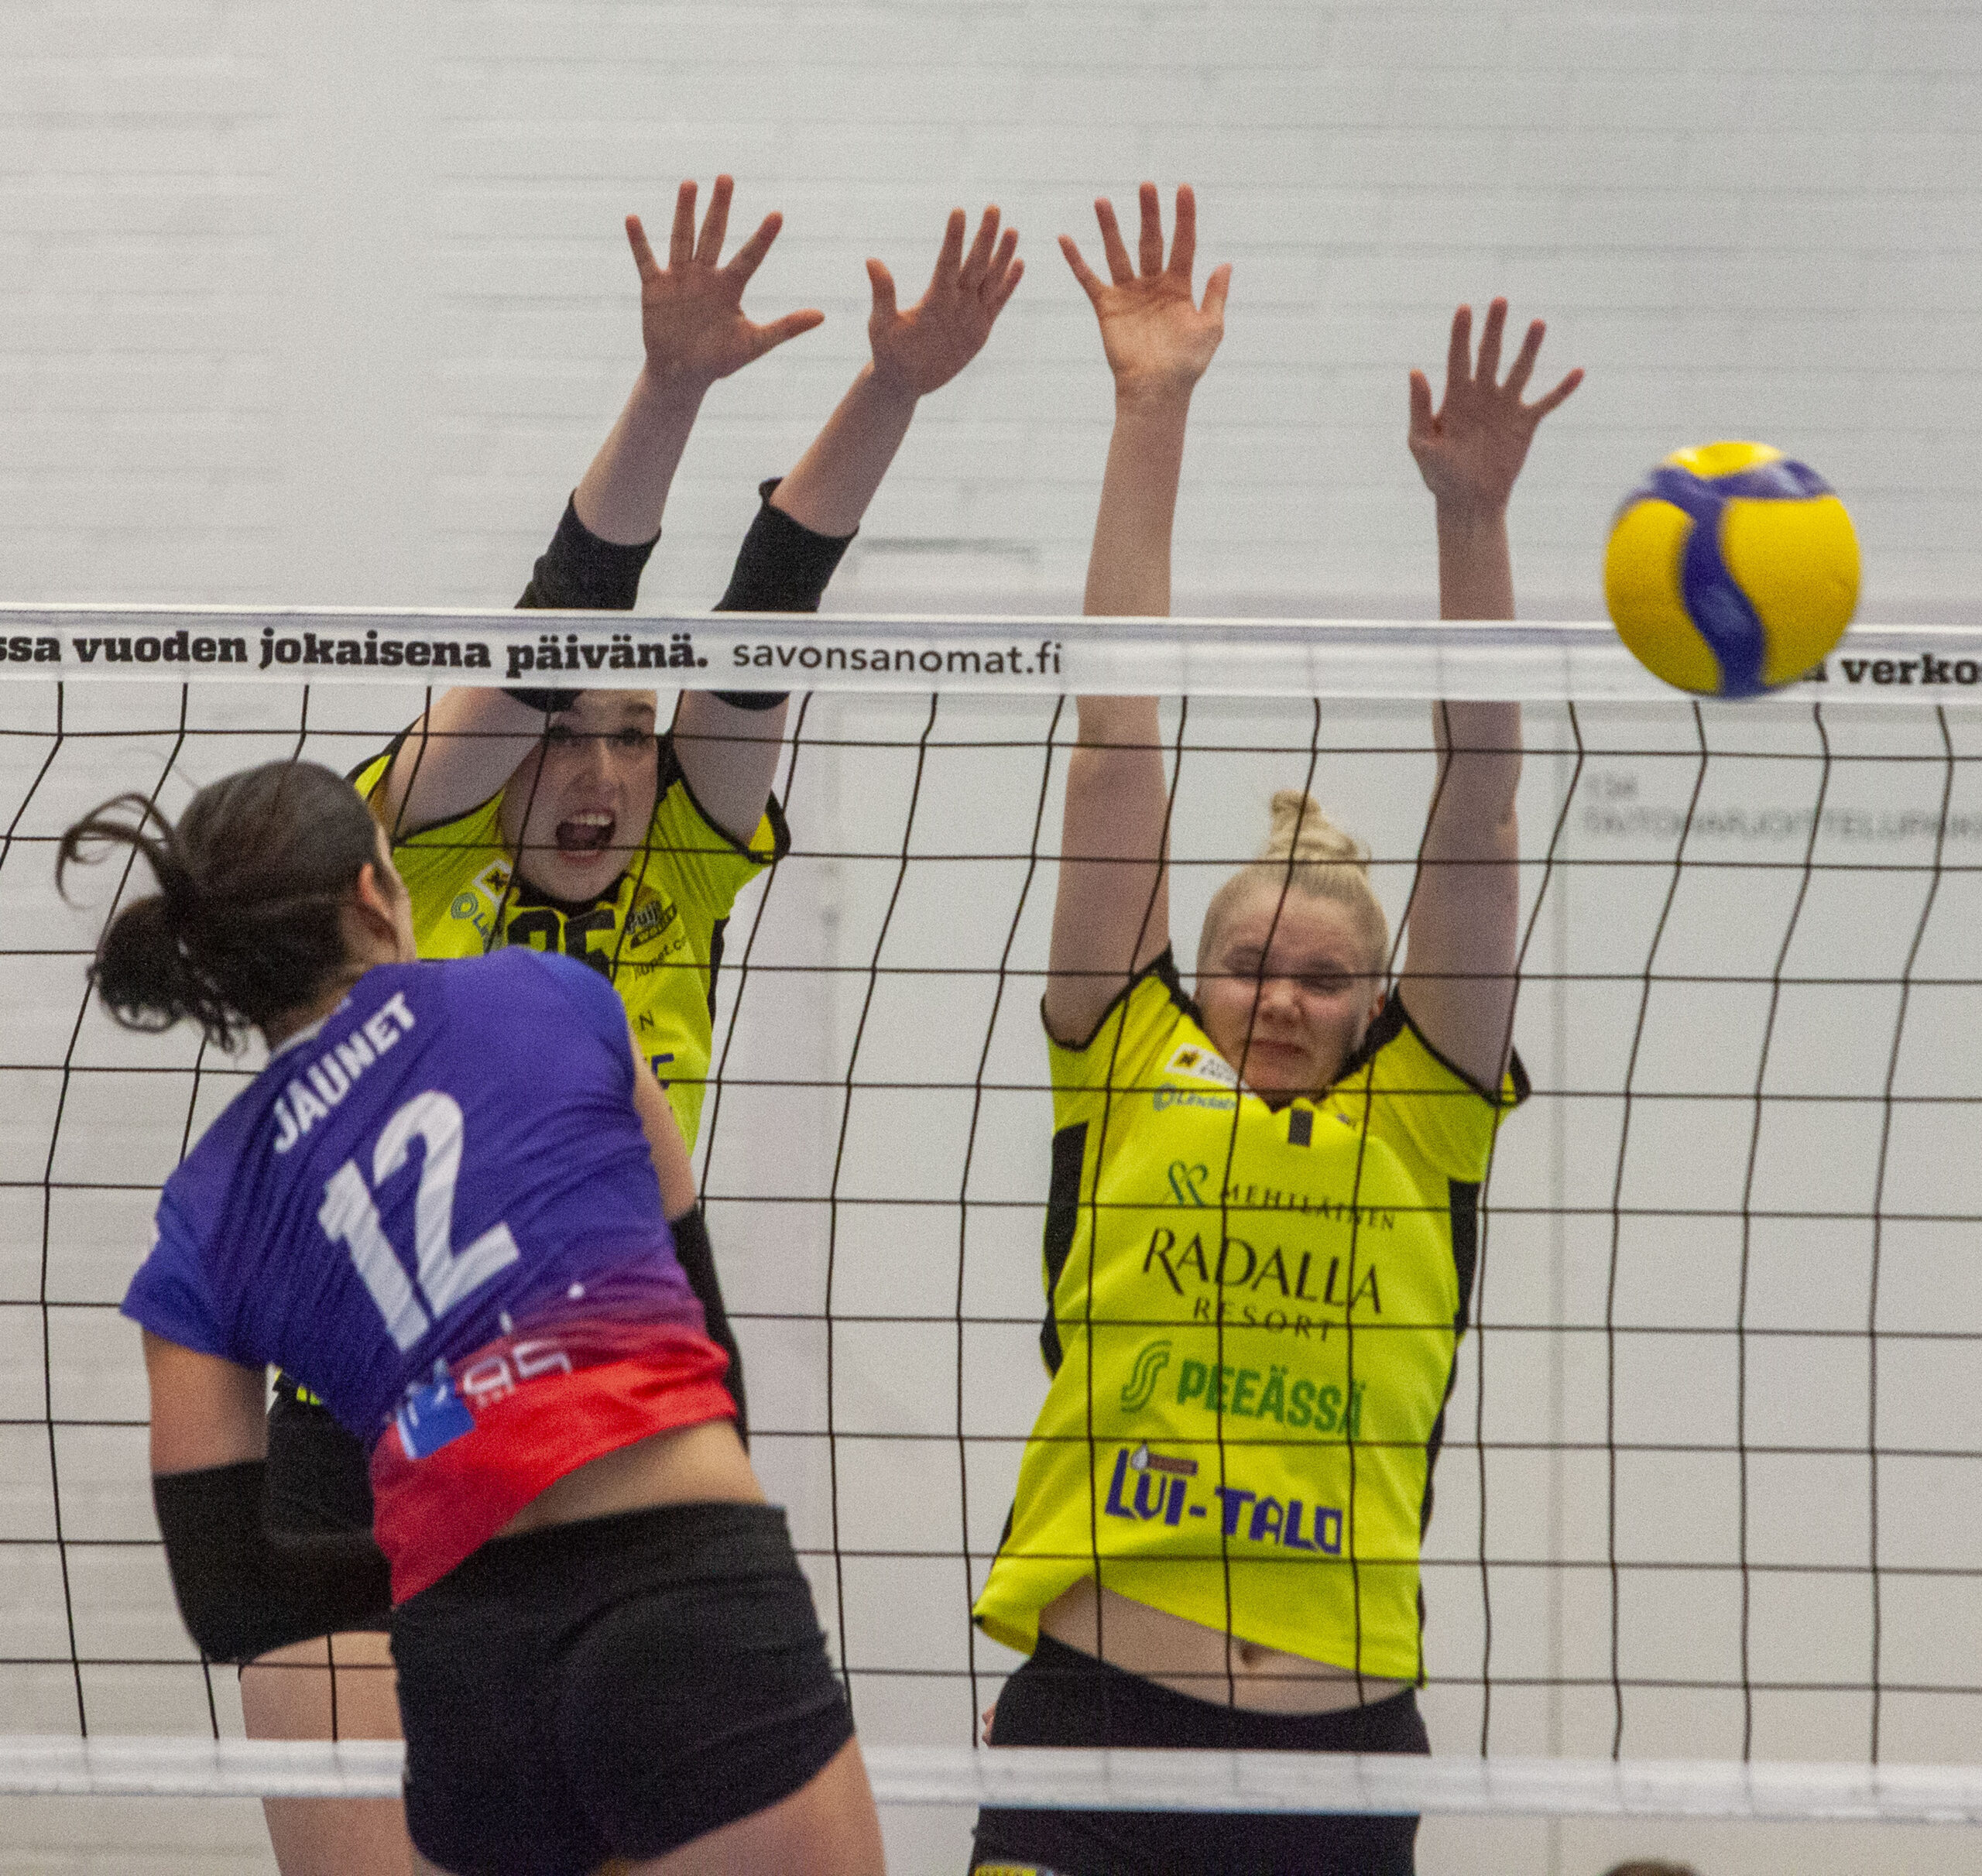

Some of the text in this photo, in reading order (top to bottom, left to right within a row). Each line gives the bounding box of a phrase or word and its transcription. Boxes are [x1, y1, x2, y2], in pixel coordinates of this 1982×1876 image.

[72, 629, 248, 663] vuoden
[259, 627, 491, 670] jokaisena
[506, 633, 708, 678] päivänä.
[732, 640, 1061, 674] savonsanomat.fi
[1841, 653, 1982, 684] verko
[273, 992, 416, 1154] JAUNET
[318, 1089, 520, 1353] 12
[1143, 1226, 1382, 1315] RADALLA
[1193, 1295, 1331, 1343] RESORT
[1175, 1357, 1367, 1440] PEEÄSSÄ
